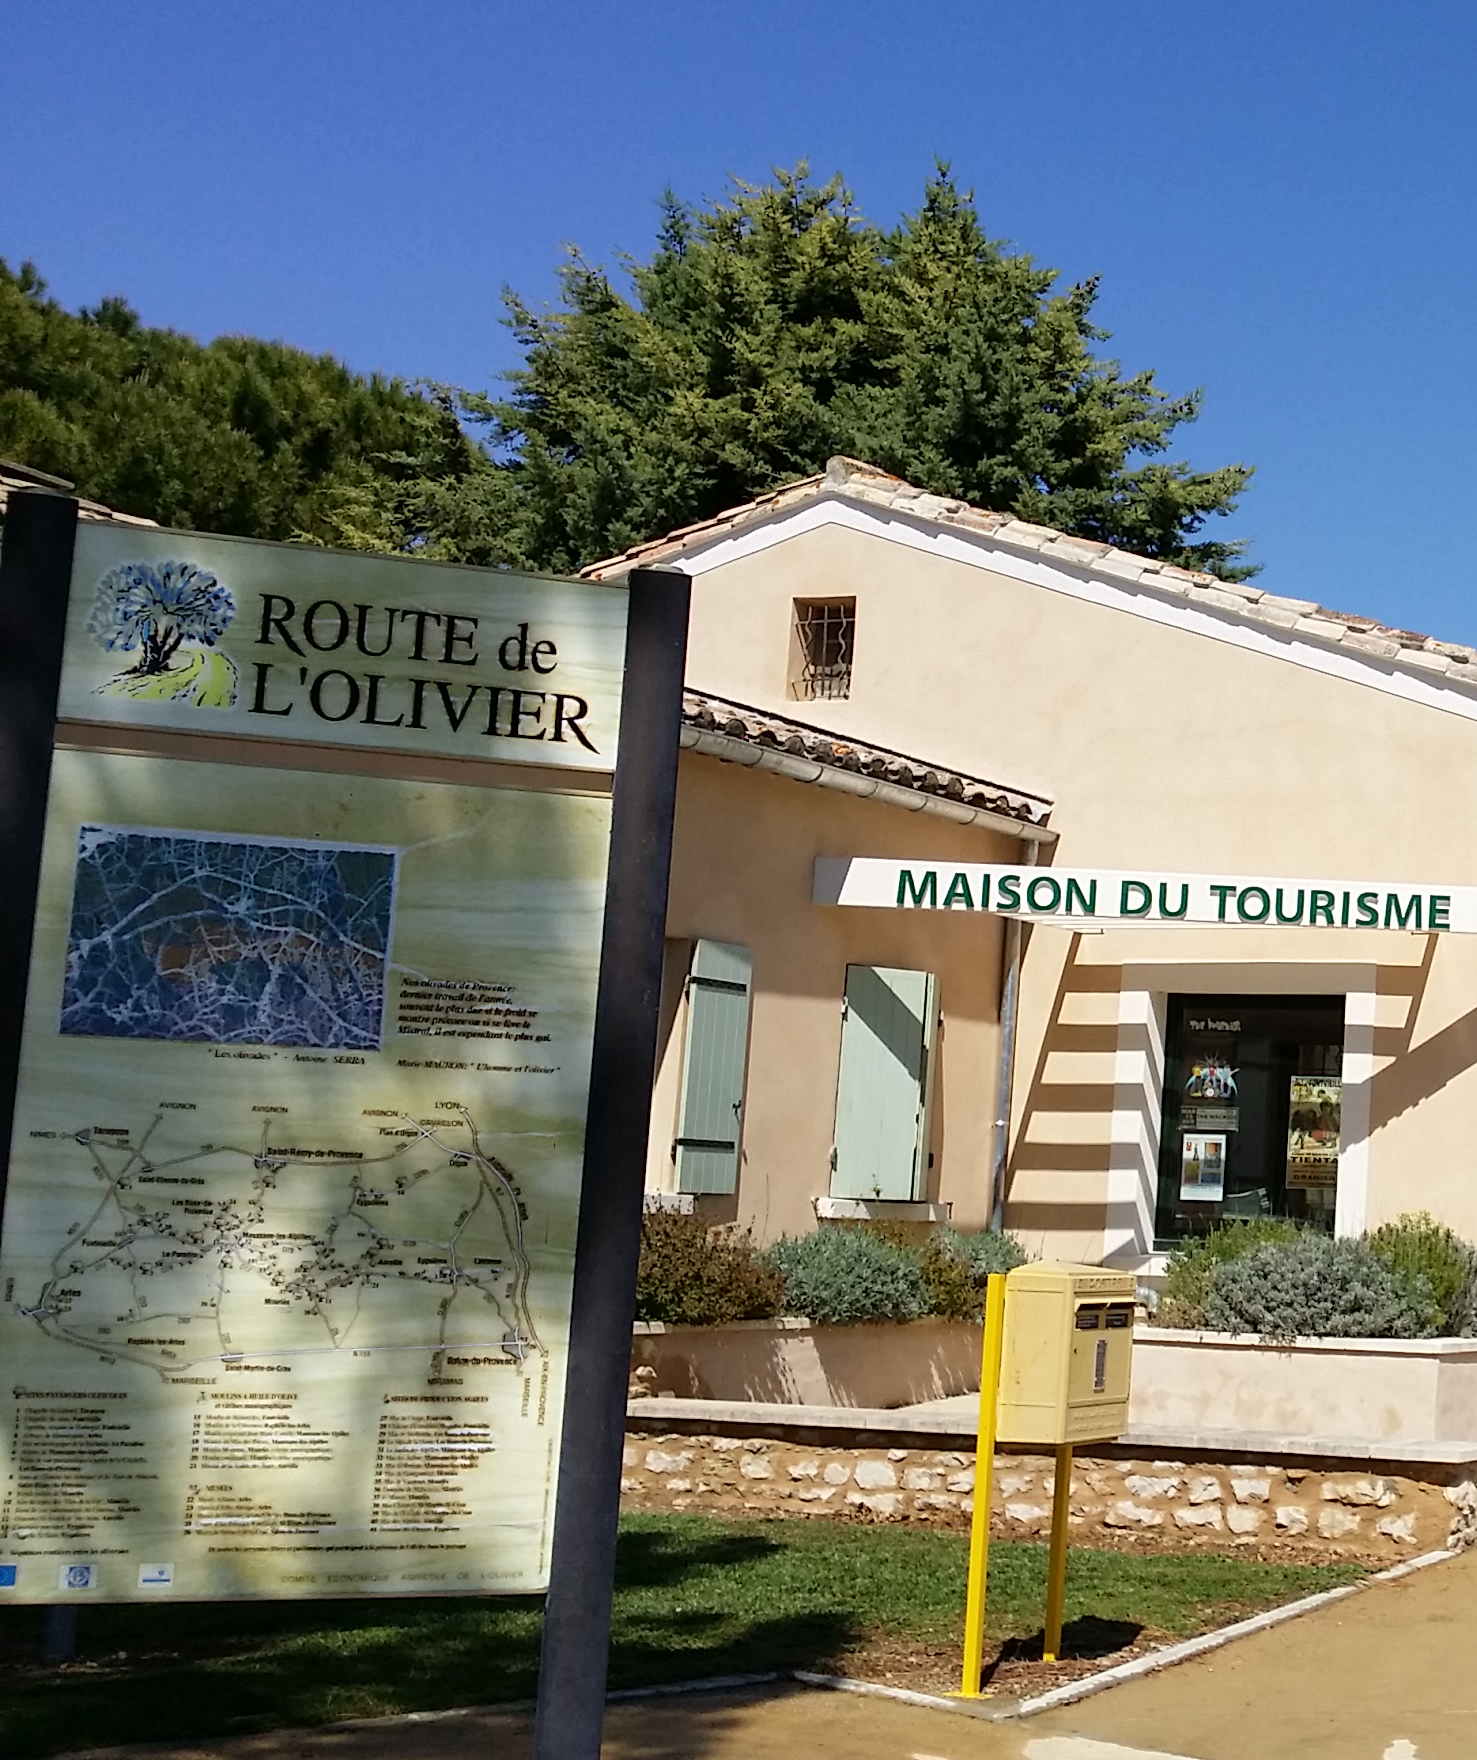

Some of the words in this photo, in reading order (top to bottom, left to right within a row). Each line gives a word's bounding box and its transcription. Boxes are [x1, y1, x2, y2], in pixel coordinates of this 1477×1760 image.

[254, 593, 479, 666] ROUTE
[498, 622, 558, 675] de
[248, 662, 601, 755] L'OLIVIER
[897, 869, 1098, 916] MAISON
[1120, 879, 1190, 920] DU
[1209, 884, 1452, 931] TOURISME
[434, 991, 464, 1001] travail
[466, 993, 476, 1002] de
[514, 1032, 534, 1043] plus
[214, 1049, 231, 1059] Les
[293, 1053, 328, 1063] Antoine
[332, 1055, 366, 1065] SERRA
[159, 1102, 197, 1110] AVIGNON
[251, 1105, 289, 1114] AVIGNON
[434, 1101, 461, 1110] LYON
[362, 1109, 399, 1117] AVIGNON
[419, 1119, 464, 1127] CAVAILLON
[60, 1288, 82, 1297] Arles
[171, 1377, 217, 1385] MARSEILLE
